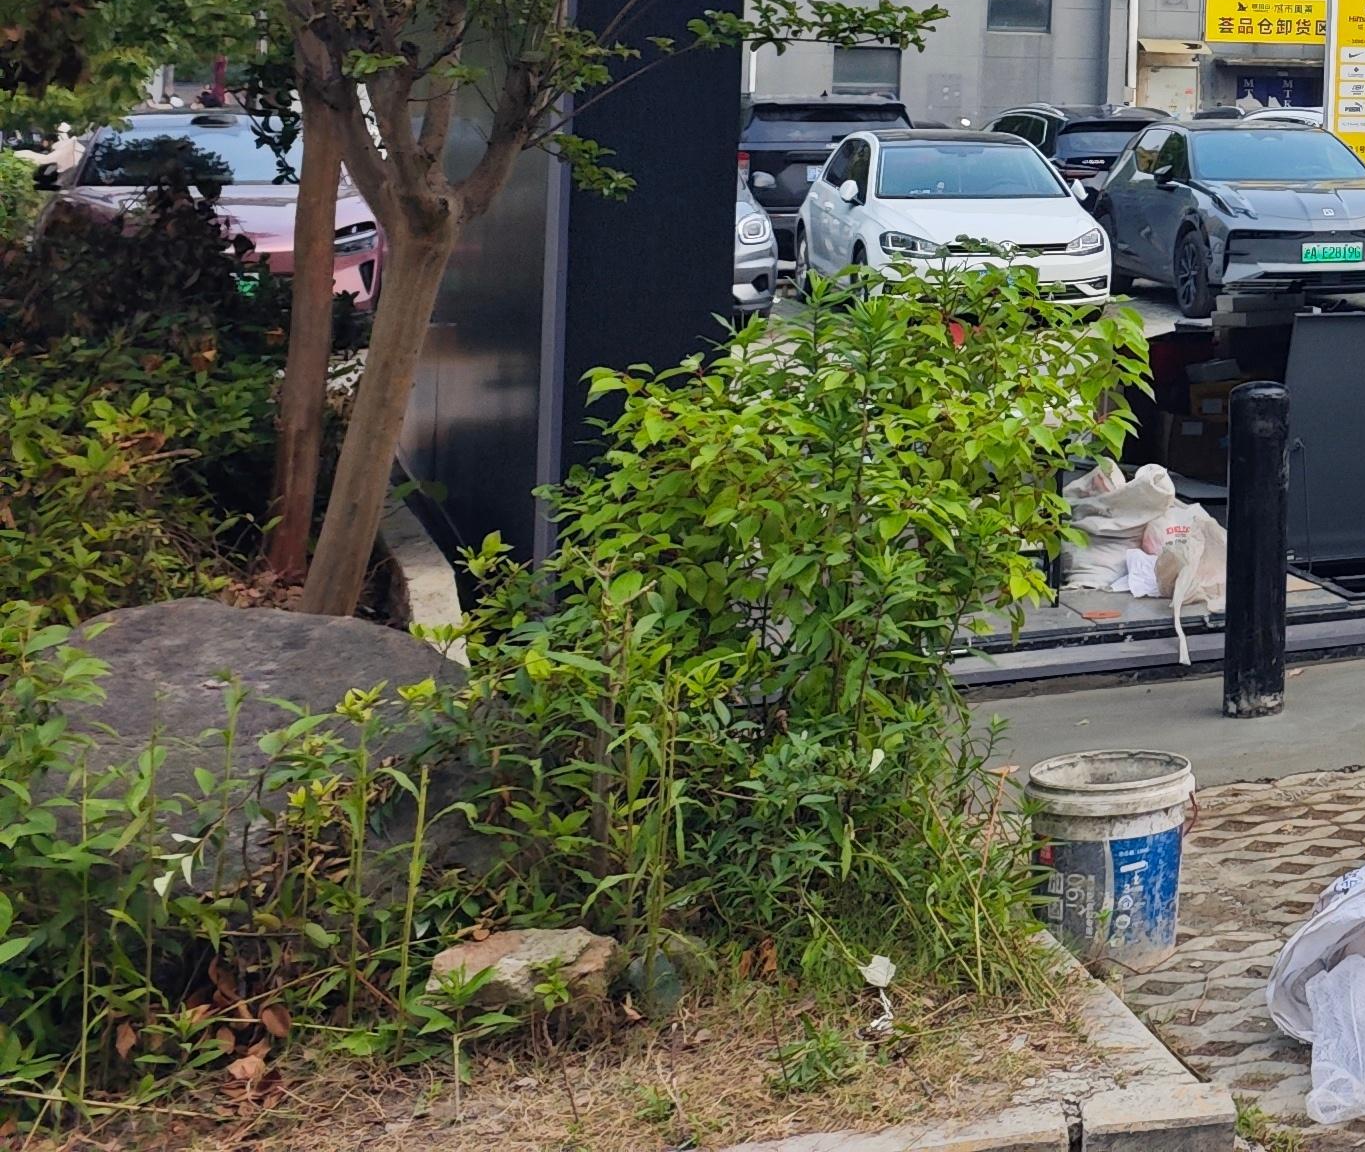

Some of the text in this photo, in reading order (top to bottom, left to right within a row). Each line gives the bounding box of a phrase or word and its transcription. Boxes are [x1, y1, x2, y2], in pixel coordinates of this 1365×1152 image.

[1218, 17, 1326, 36] 荟品仓卸货区
